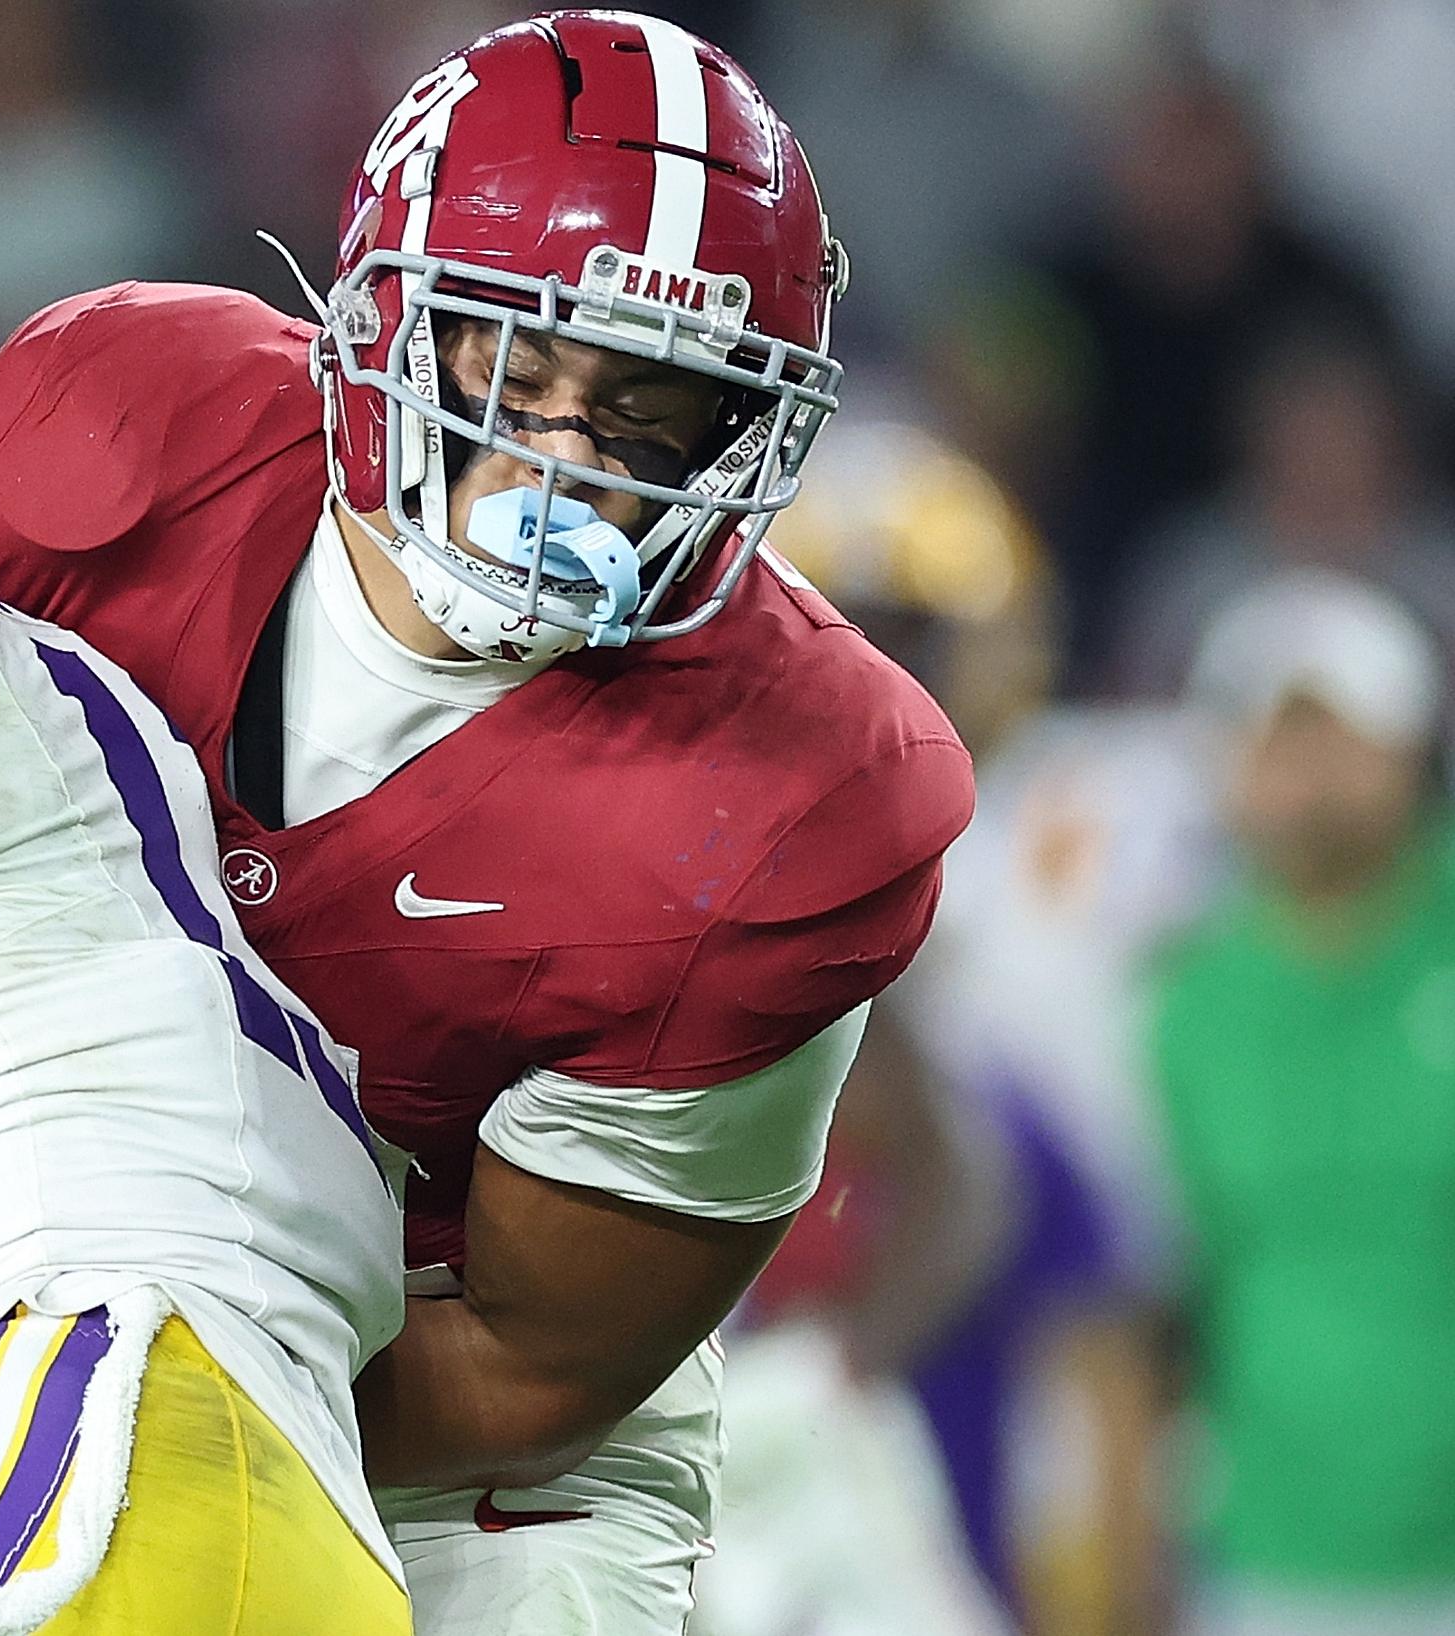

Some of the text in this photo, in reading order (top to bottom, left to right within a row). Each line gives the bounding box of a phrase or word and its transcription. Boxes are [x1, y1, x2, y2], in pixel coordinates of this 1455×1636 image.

[622, 264, 707, 312] BAMA
[413, 354, 439, 454] CRSON
[715, 409, 779, 480] RIMSON
[675, 479, 719, 521] TIE
[227, 858, 266, 895] A
